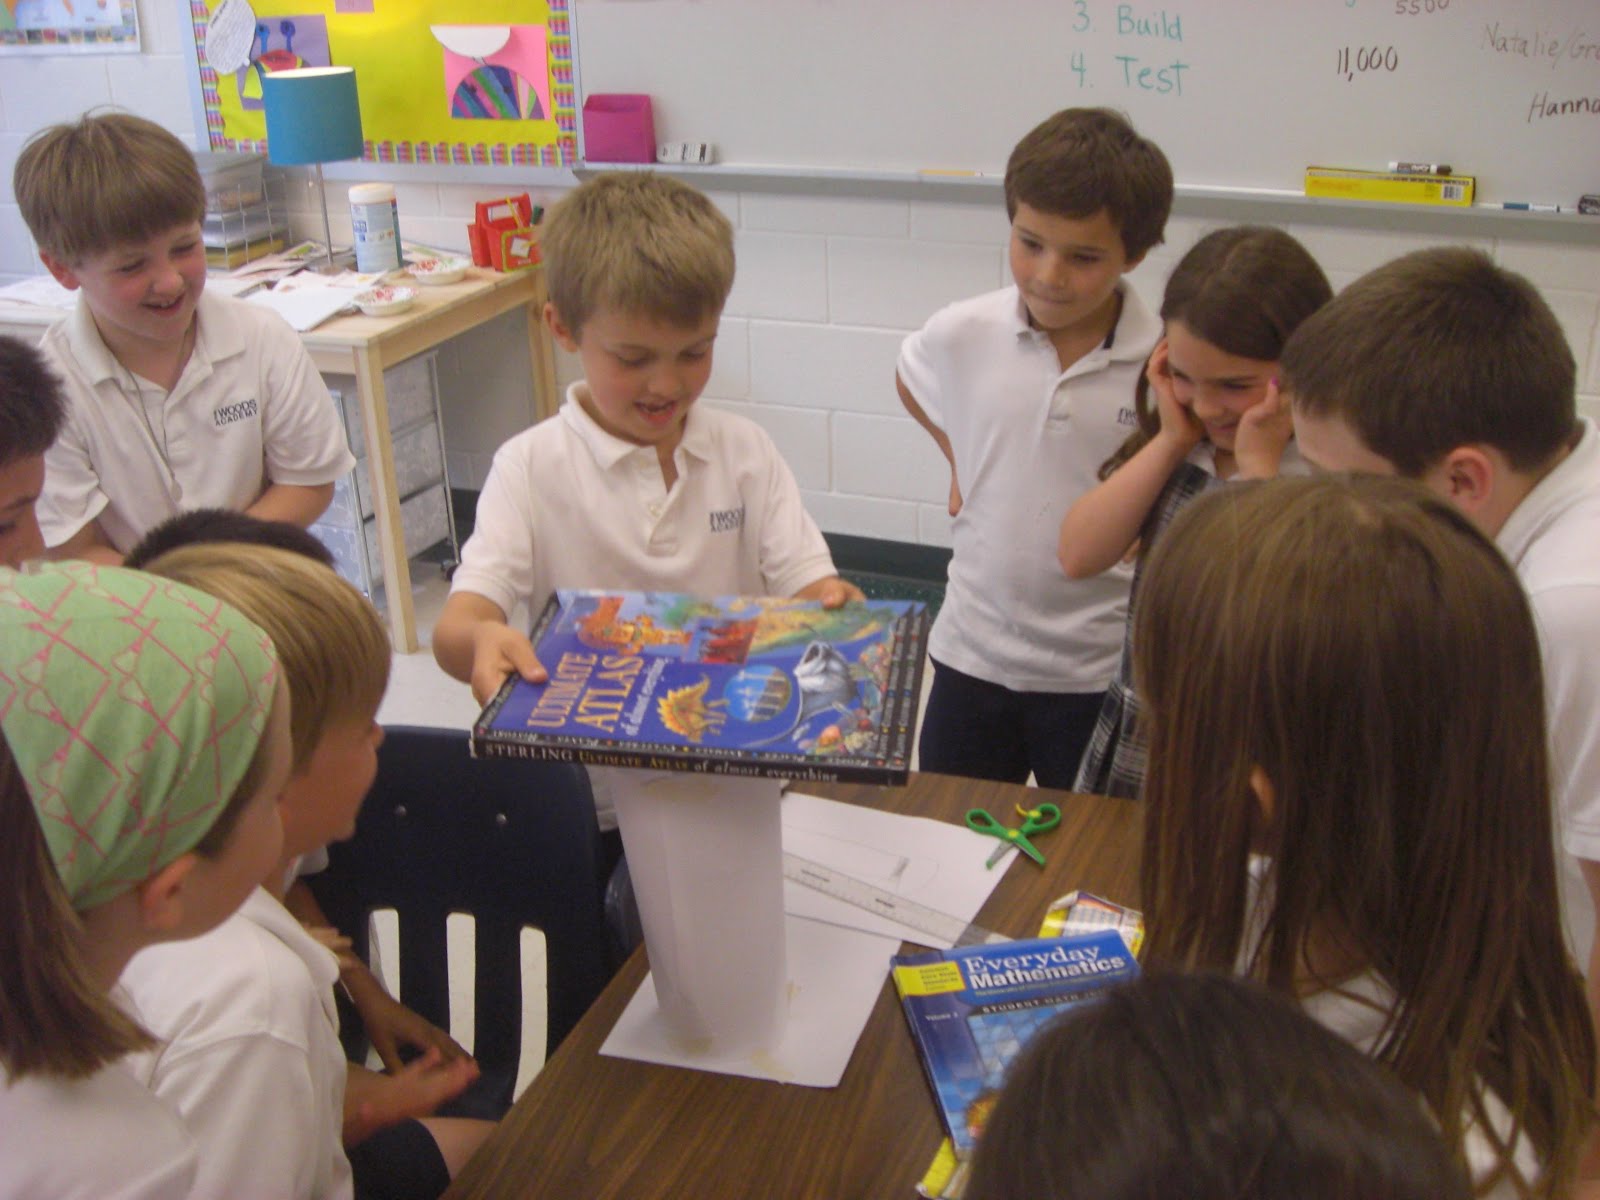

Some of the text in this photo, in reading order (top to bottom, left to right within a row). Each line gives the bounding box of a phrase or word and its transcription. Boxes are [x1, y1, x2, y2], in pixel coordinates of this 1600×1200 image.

[1117, 4, 1183, 42] Build
[1113, 54, 1190, 97] Test
[1337, 46, 1398, 82] 11,000
[218, 399, 257, 417] WOODS
[574, 655, 645, 733] ATLAS
[484, 742, 573, 762] STERLING
[694, 759, 707, 772] of
[714, 760, 759, 776] almost
[766, 767, 838, 783] everything
[963, 946, 1100, 974] Everyday
[968, 956, 1125, 990] Mathematics
[982, 999, 1040, 1014] STUDENT
